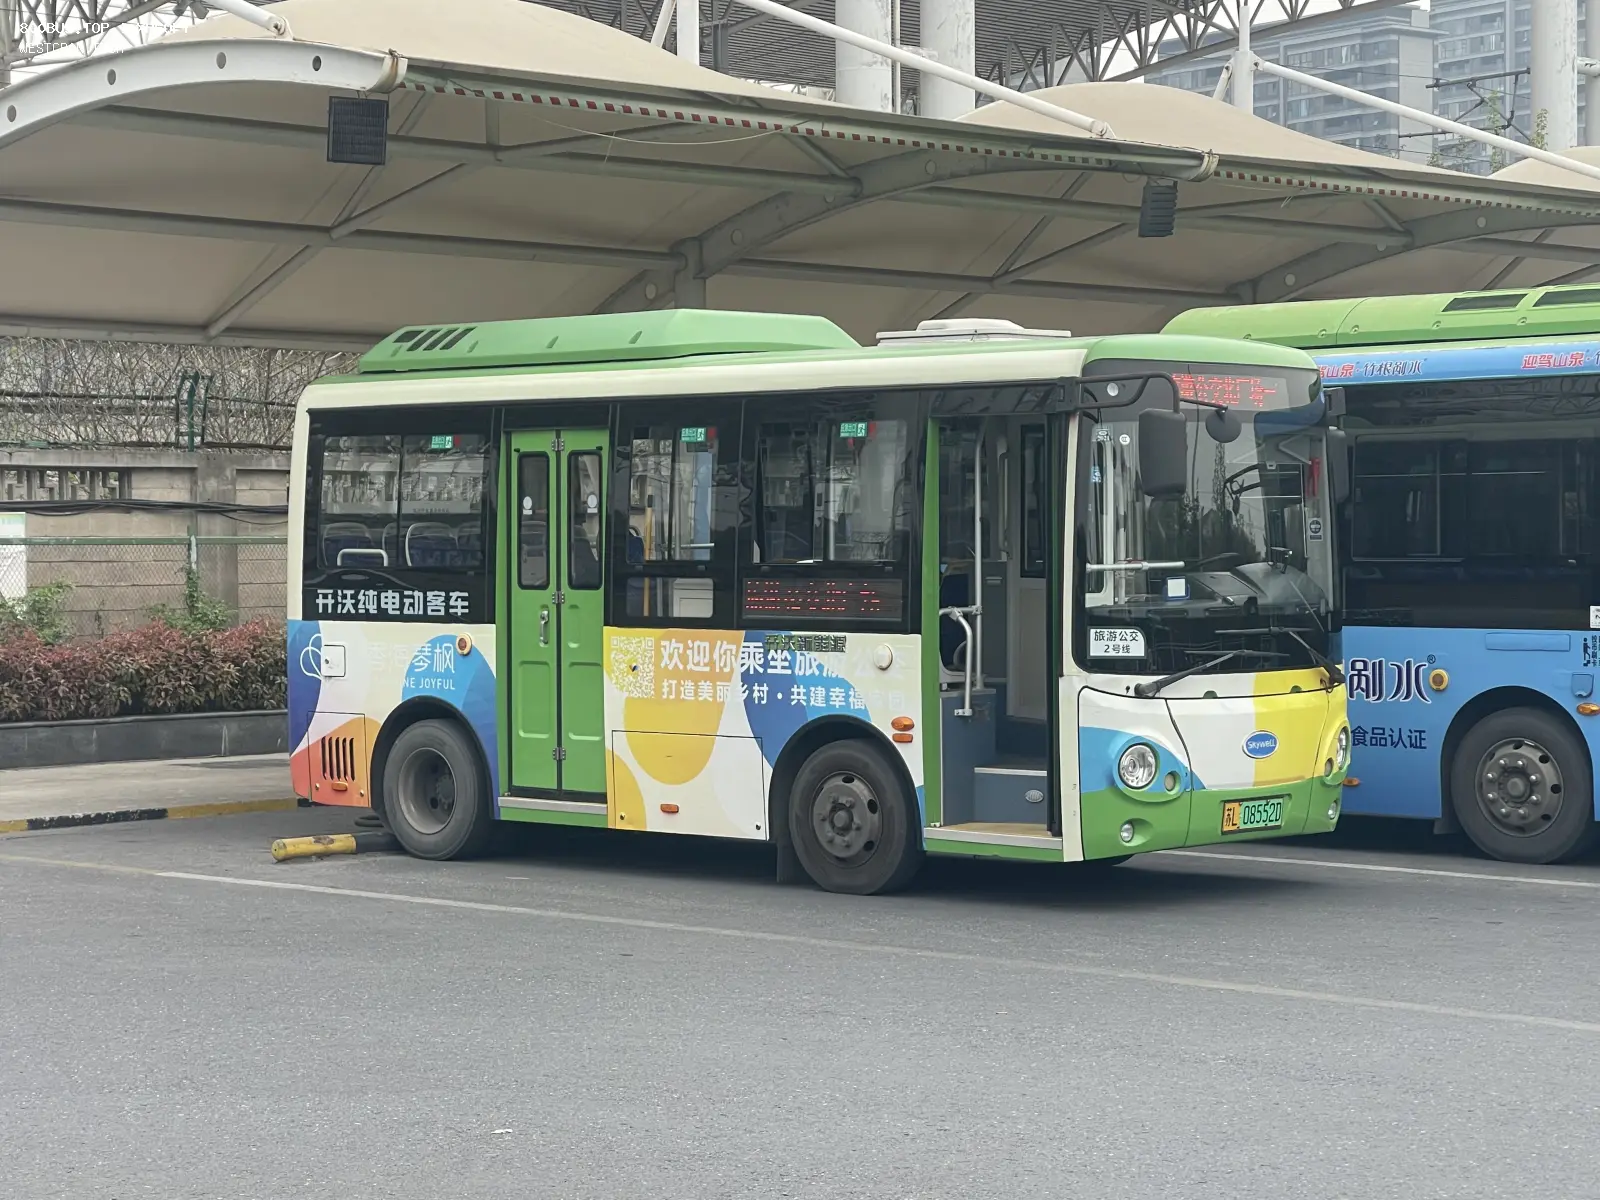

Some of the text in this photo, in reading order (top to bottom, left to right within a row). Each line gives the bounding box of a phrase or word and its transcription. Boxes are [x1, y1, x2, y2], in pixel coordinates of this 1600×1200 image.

[315, 589, 469, 616] 开沃纯电动客车
[1094, 630, 1139, 642] 旅游公交
[1104, 644, 1131, 654] 2号线
[419, 678, 456, 690] JOYFUL
[1351, 725, 1427, 749] 食品认证
